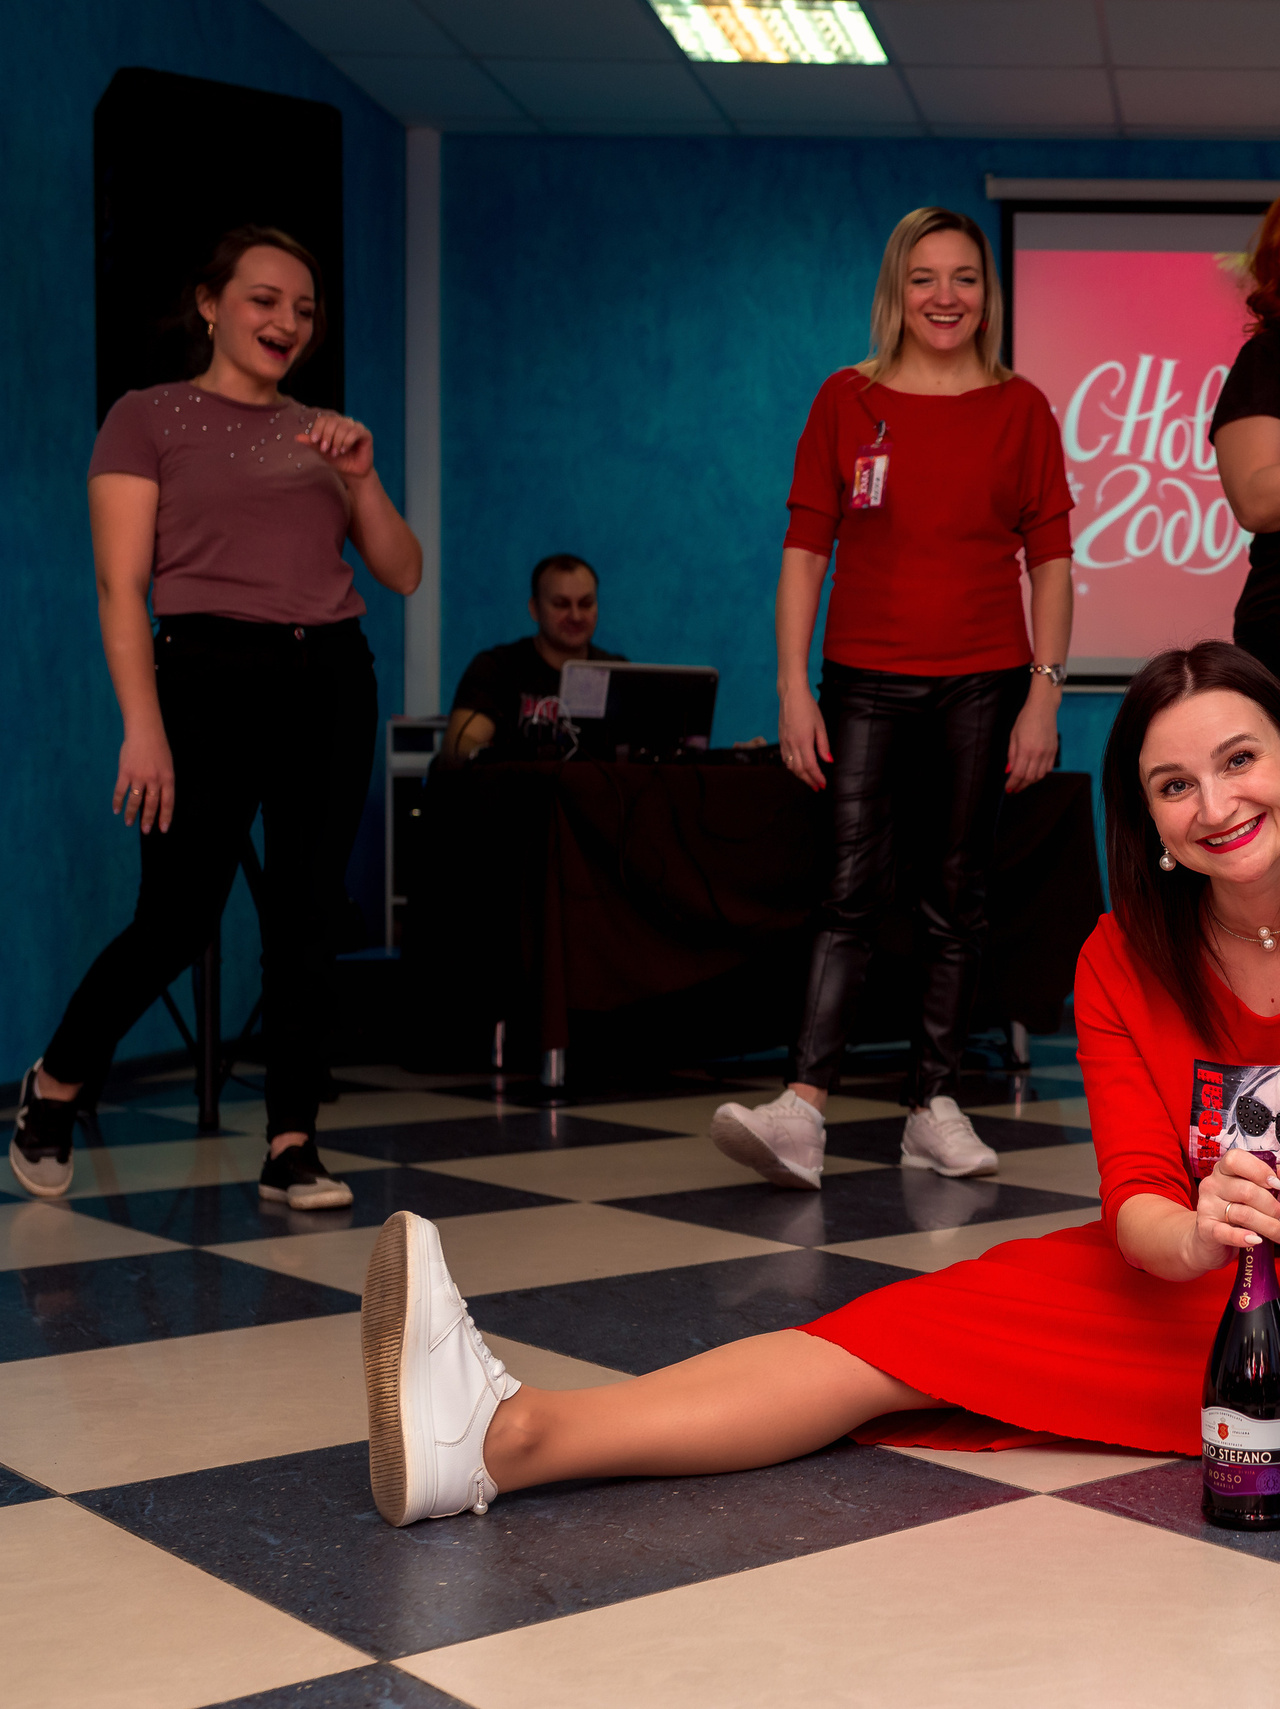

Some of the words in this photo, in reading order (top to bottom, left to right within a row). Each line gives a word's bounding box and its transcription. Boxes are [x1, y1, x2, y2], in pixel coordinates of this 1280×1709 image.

[1073, 463, 1254, 575] Годо
[1243, 1255, 1254, 1288] SANTO
[1203, 1444, 1216, 1457] NTO
[1218, 1448, 1272, 1463] STEFANO
[1208, 1468, 1242, 1484] ROSSO
